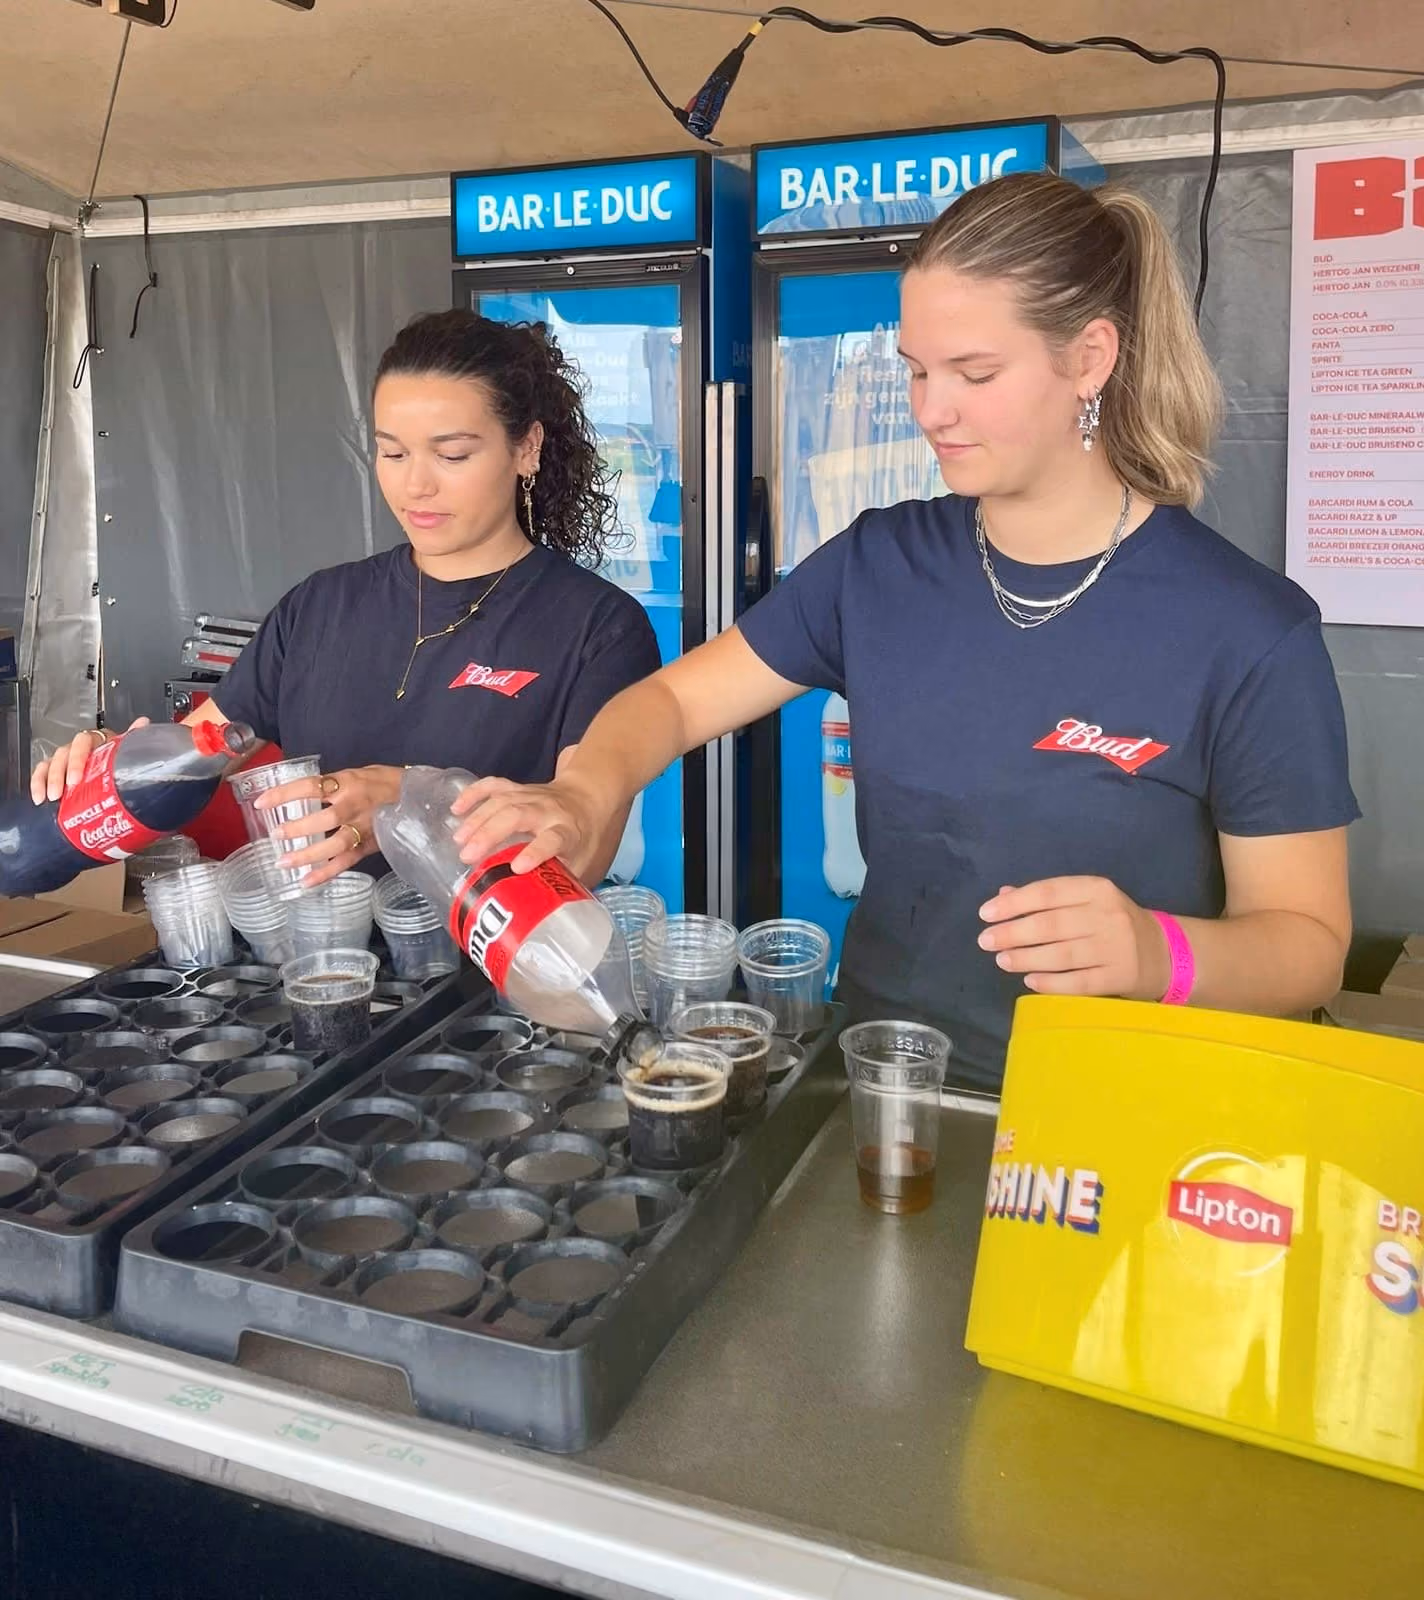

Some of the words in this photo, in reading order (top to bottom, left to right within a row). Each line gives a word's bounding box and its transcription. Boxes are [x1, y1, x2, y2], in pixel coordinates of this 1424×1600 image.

[1313, 156, 1424, 240] B
[1313, 255, 1333, 263] BUD
[1313, 267, 1351, 277] HERTOG
[1352, 266, 1371, 275] JAN
[1372, 263, 1420, 273] WEIZENER
[1313, 282, 1350, 292] HERTOG
[1351, 280, 1371, 290] JAN
[1312, 311, 1368, 320] COCA-COLA
[1312, 326, 1368, 335] COCA-COLA
[1369, 324, 1394, 333] ZERO
[1312, 341, 1341, 349] FANTA
[1312, 355, 1342, 364] SPRITE
[1311, 370, 1344, 378] LIPTON
[1345, 369, 1360, 377] ICE
[1361, 368, 1379, 376] TEA
[1380, 367, 1413, 376] GREEN
[1311, 384, 1343, 393] LIPTON
[1361, 383, 1379, 391] TEA
[1310, 412, 1367, 420] BAR-LE-DUC
[1310, 427, 1367, 435] BAR-LE-DUC
[1369, 426, 1415, 434] BRUISEND
[1310, 441, 1367, 449] BAR-LE-DUC
[1368, 440, 1415, 449] BRUISEND
[1309, 470, 1345, 478] ENERGY
[1346, 470, 1375, 478] DRINK
[1308, 499, 1355, 507] BARCARDI
[1356, 499, 1377, 507] RUM
[1379, 499, 1386, 507] &
[1387, 499, 1414, 507] COLA
[1308, 513, 1349, 521] BACARDI
[1350, 513, 1375, 521] RAZZ
[1376, 513, 1383, 521] &
[1384, 513, 1398, 521] UP
[1308, 527, 1348, 535] BACARDI
[1349, 528, 1379, 536] LIMON
[1381, 528, 1387, 536] &
[1389, 528, 1424, 536] LEMON
[1308, 542, 1349, 550] BACARDI
[1350, 542, 1390, 551] BREEZER
[1309, 556, 1332, 564] JACK
[1333, 556, 1373, 565] DANIEL'S
[1375, 557, 1382, 565] &
[465, 665, 517, 686] Bud
[1056, 719, 1152, 761] Bud
[63, 803, 103, 830] RECYCLE
[101, 795, 118, 810] ME
[1178, 1187, 1281, 1237] Lipton
